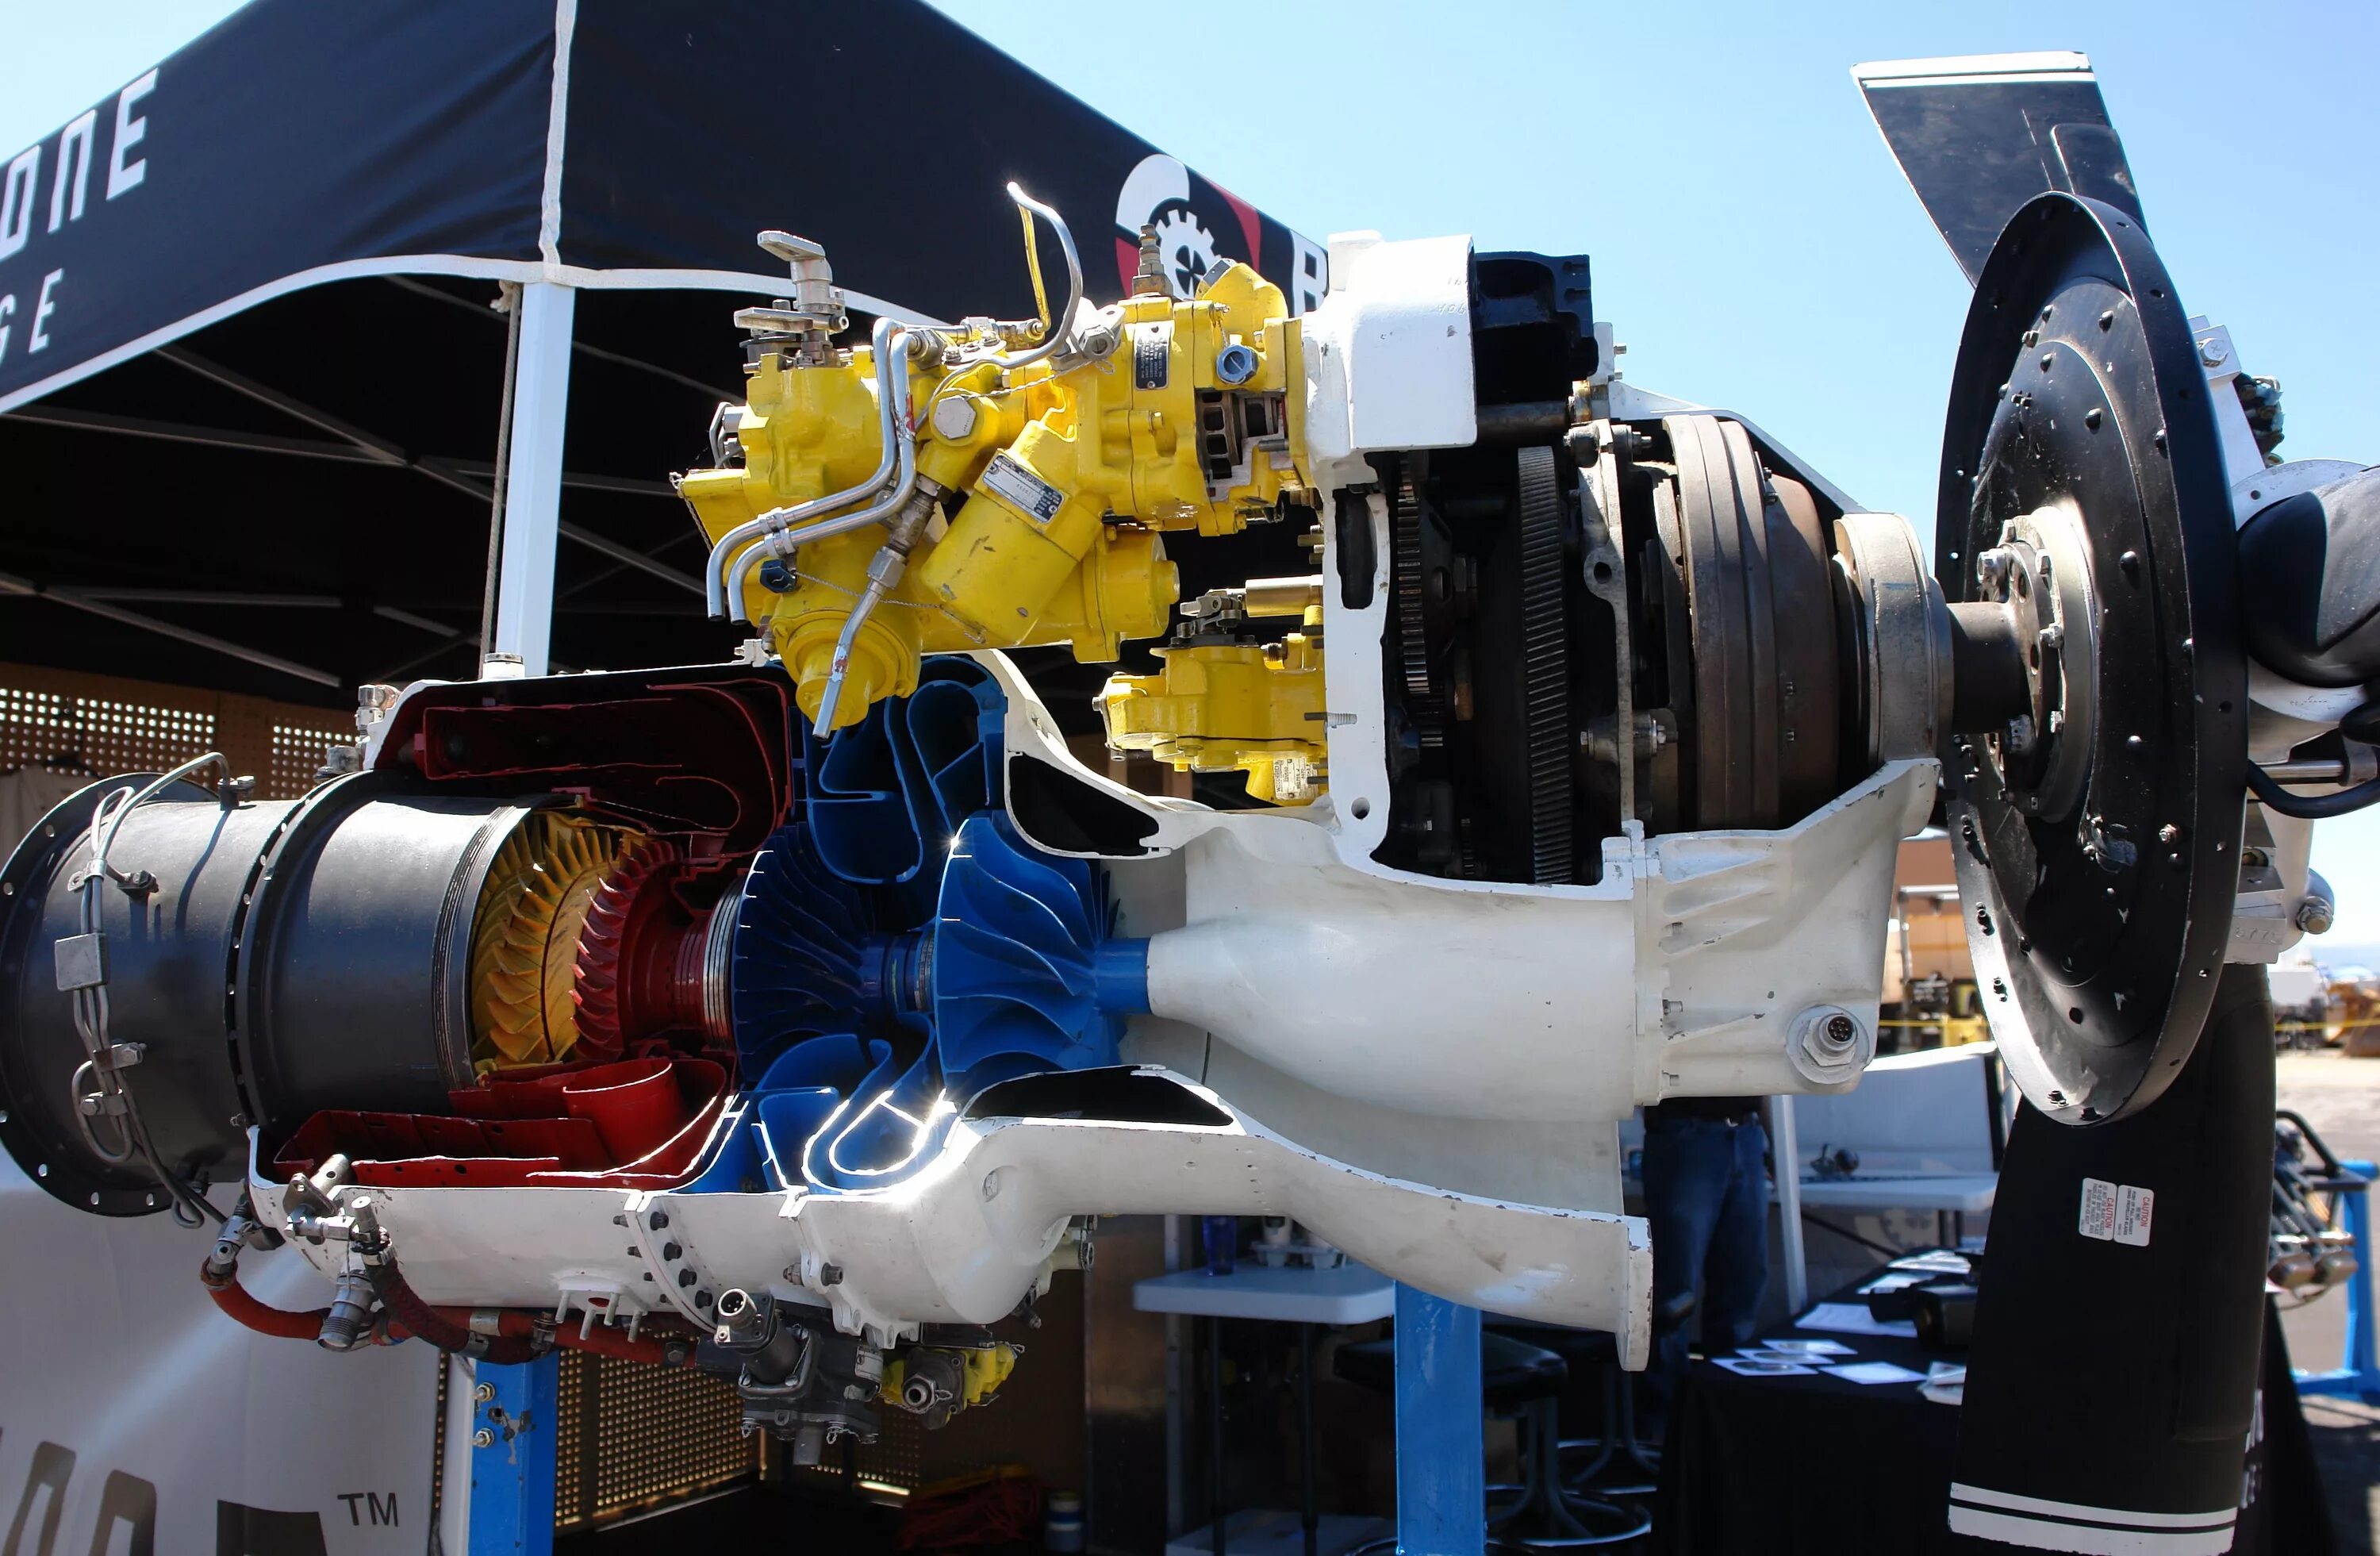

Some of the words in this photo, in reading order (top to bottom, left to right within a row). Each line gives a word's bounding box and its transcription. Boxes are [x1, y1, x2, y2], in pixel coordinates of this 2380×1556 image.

[2105, 1197, 2113, 1228] CAUTION
[2140, 1197, 2150, 1227] CAUTION
[337, 1493, 398, 1527] TM
